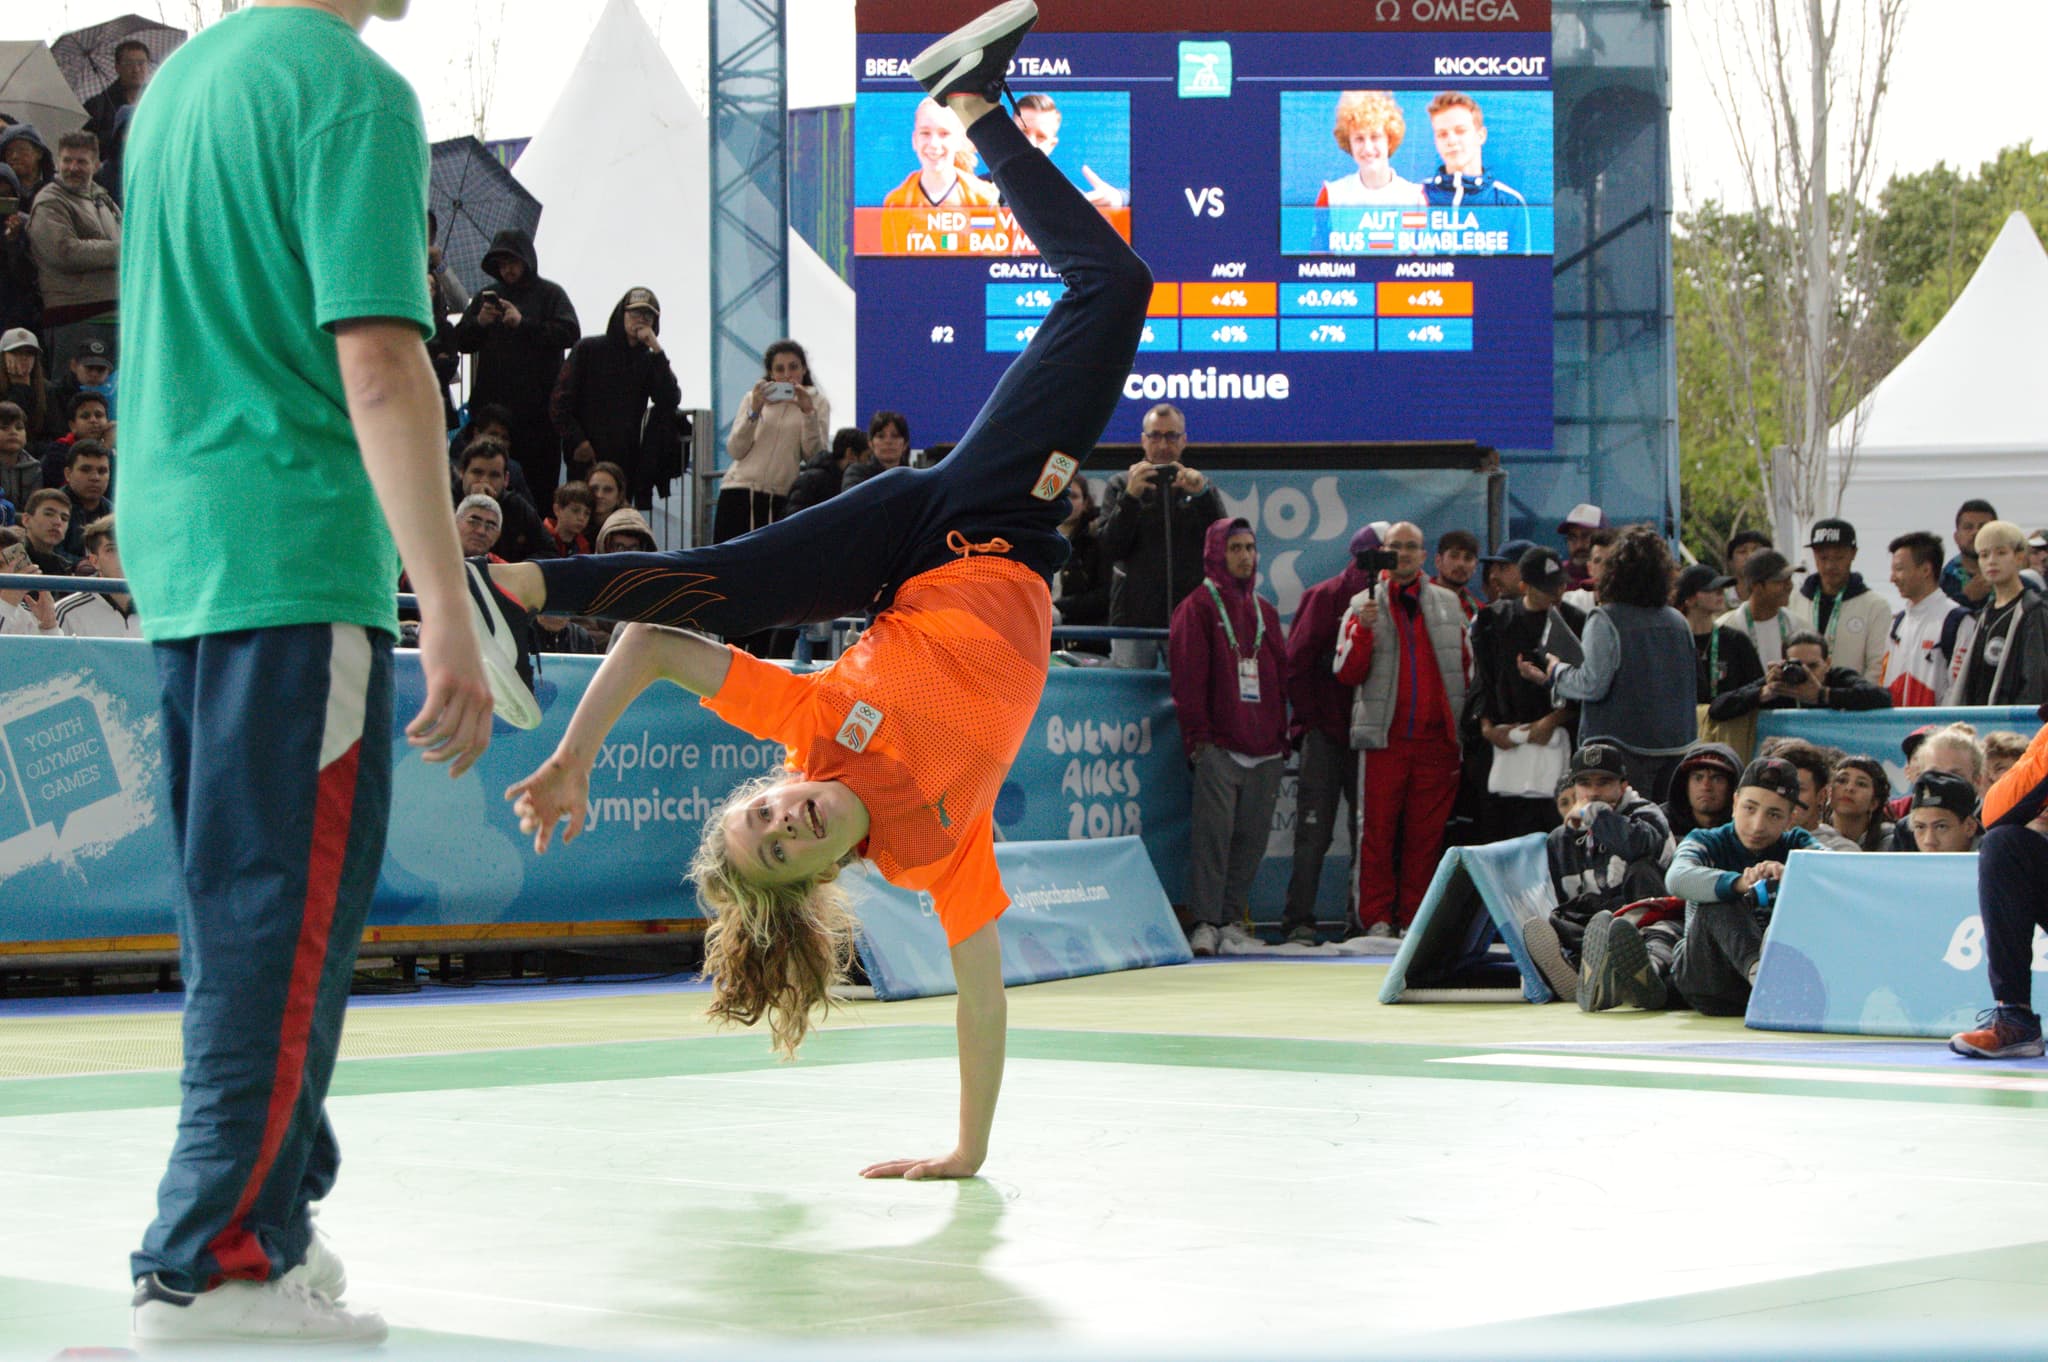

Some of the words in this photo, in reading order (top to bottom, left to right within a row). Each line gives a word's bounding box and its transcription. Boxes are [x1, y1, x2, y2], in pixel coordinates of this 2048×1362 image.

[1411, 0, 1520, 22] OMEGA
[865, 58, 914, 77] BREA
[1018, 58, 1072, 77] TEAM
[1434, 57, 1546, 76] KNOCK-OUT
[1184, 187, 1225, 218] VS
[927, 213, 967, 232] NED
[1358, 211, 1398, 230] AUT
[1431, 211, 1479, 230] ELLA
[906, 233, 936, 251] ITA
[969, 233, 1010, 252] BAD
[1329, 231, 1365, 250] RUS
[1398, 231, 1509, 250] BUMBLEBEE
[988, 263, 1039, 279] CRAZY
[1211, 262, 1247, 278] MOY
[1298, 262, 1356, 278] NARUMI
[1396, 262, 1455, 278] MOUNIR
[1016, 290, 1052, 308] +1%
[1211, 290, 1248, 307] +4%
[1297, 290, 1358, 307] +0.94%
[1407, 290, 1444, 307] +4%
[930, 326, 954, 344] #2
[1211, 325, 1248, 343] +8%
[1309, 325, 1346, 343] +7%
[1407, 325, 1444, 343] +4%
[1123, 366, 1290, 400] continue
[24, 717, 84, 752] YOUTH
[26, 738, 100, 779] OLYMPIC
[594, 731, 699, 781] xplore
[41, 764, 101, 800] GAMES
[1062, 758, 1141, 798] AIRES
[1067, 801, 1142, 840] 2018
